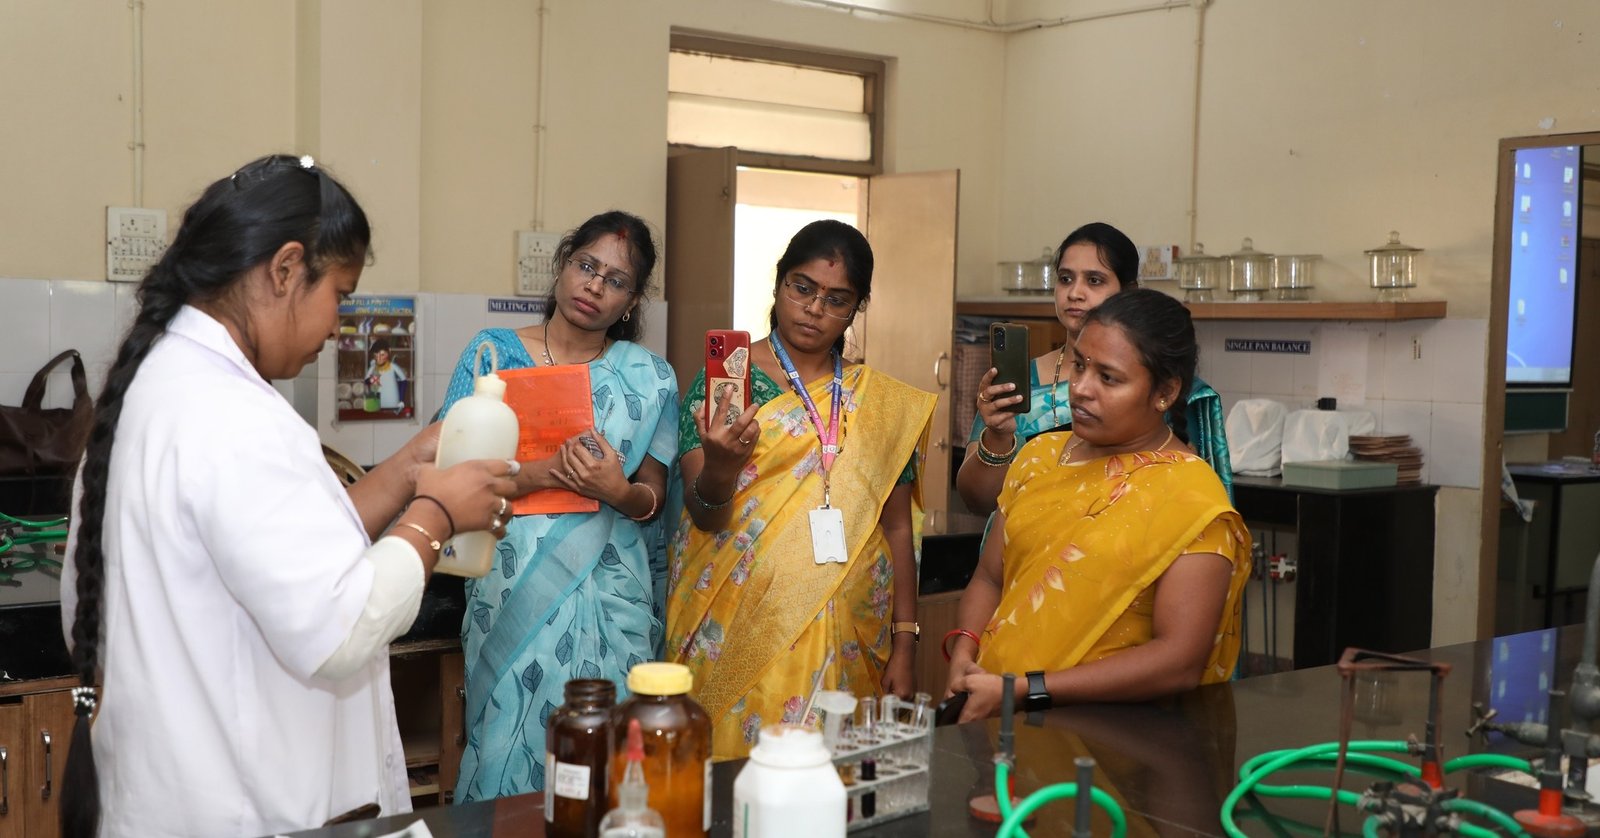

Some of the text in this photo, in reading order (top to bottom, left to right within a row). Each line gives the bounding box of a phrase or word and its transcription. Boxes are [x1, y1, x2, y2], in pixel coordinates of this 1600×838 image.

[491, 301, 527, 311] MELTING
[1226, 341, 1307, 353] SINGLE PAN BALANCE
